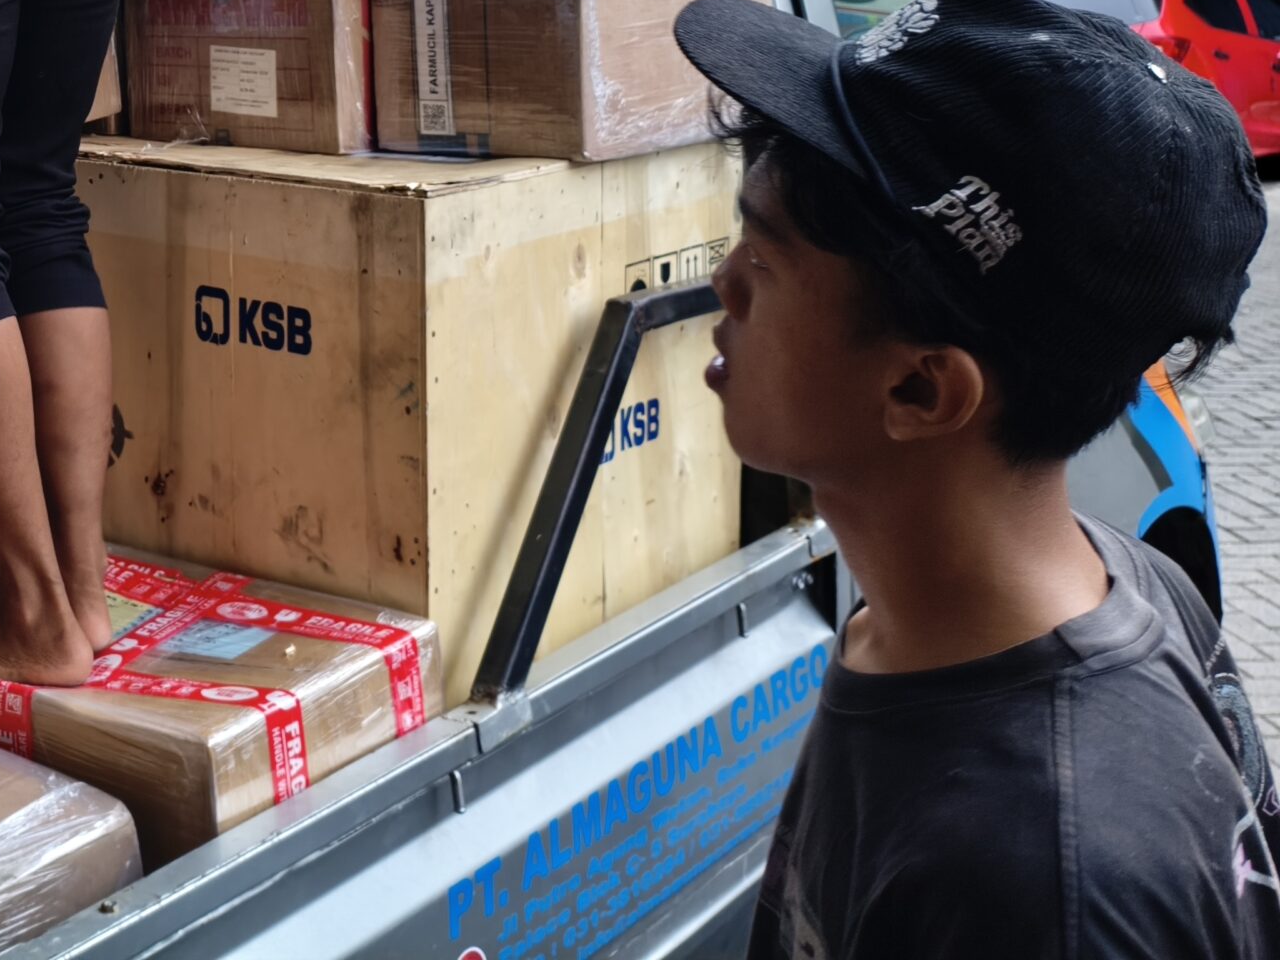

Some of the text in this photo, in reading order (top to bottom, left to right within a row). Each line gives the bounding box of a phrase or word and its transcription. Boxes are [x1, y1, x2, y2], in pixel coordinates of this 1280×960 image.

[428, 27, 439, 95] FARMUCIL
[238, 297, 312, 356] KSB
[620, 398, 660, 451] KSB
[271, 726, 284, 785] HANDLE
[448, 855, 509, 940] PT.
[522, 715, 723, 891] ALMAGUNA
[729, 643, 829, 744] CARGO
